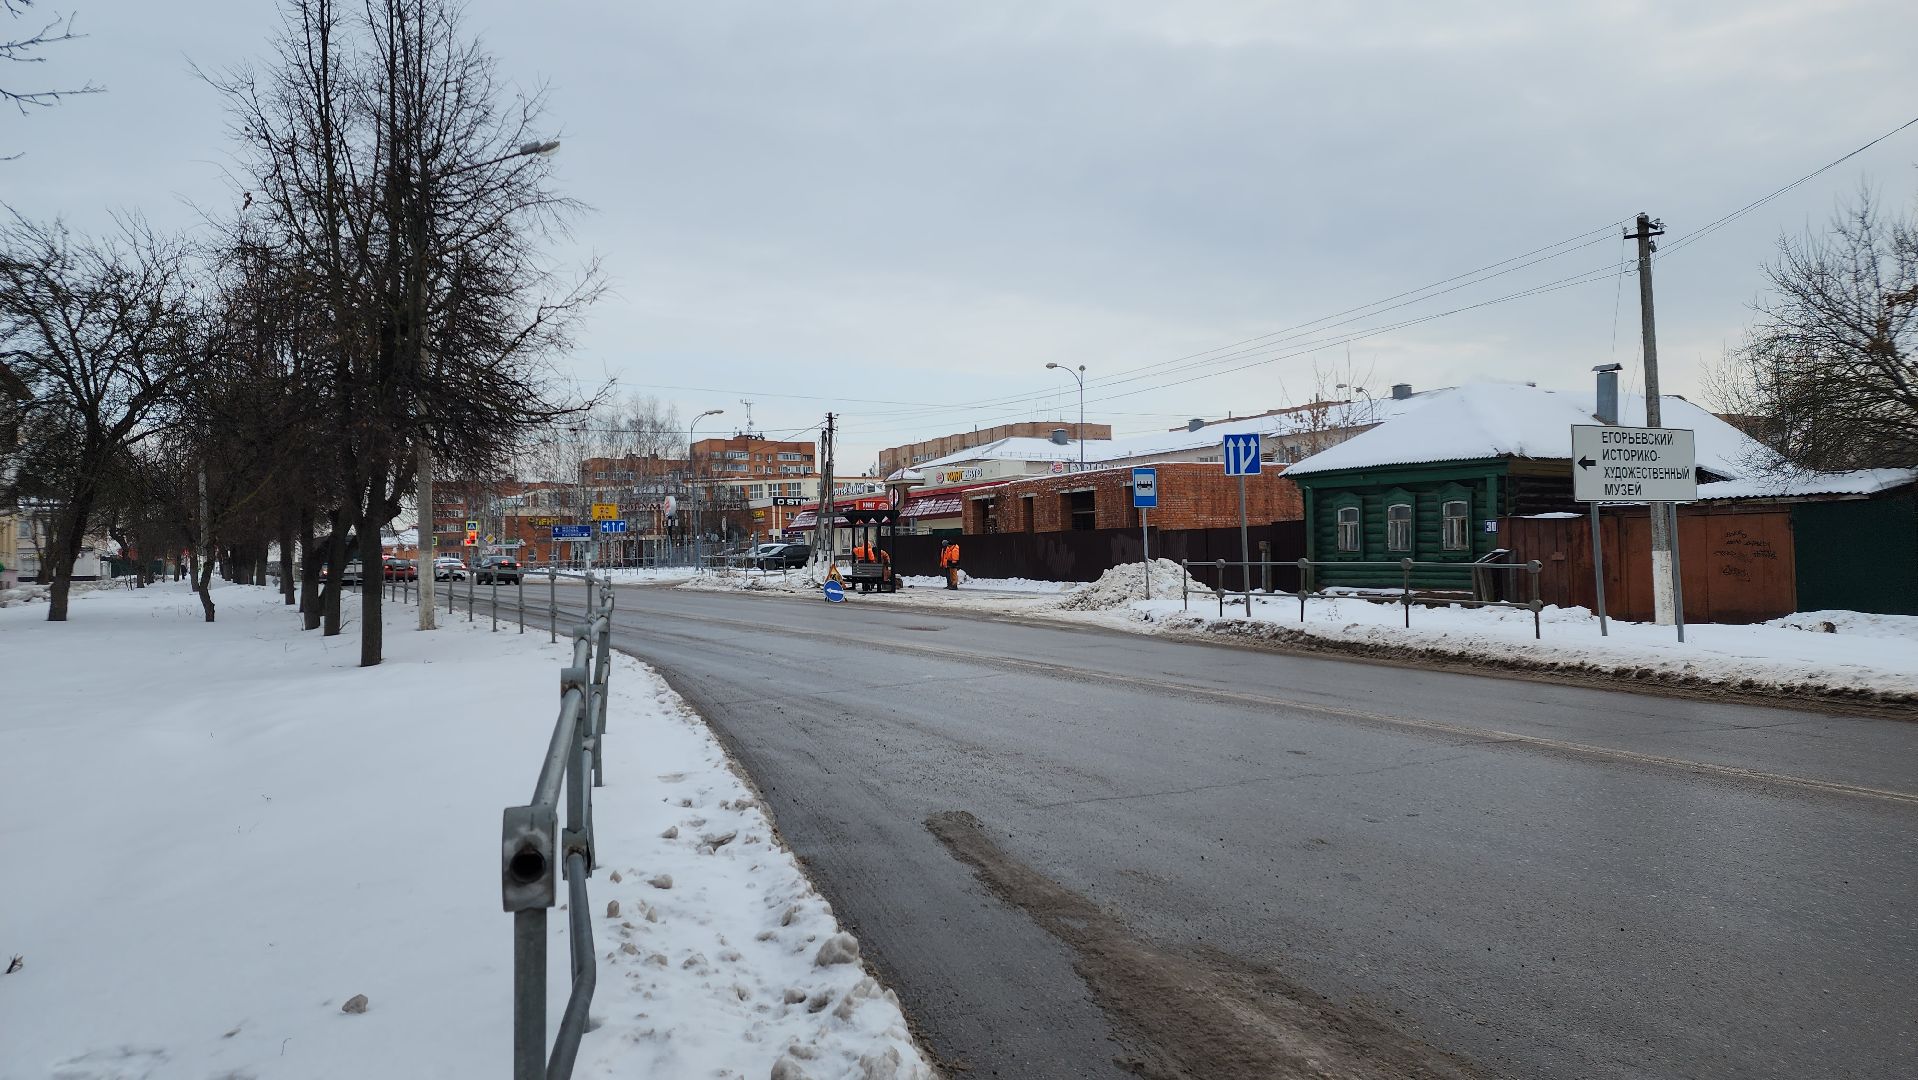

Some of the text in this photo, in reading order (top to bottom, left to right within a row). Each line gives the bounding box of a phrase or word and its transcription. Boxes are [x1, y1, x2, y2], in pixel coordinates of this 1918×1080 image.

[1601, 430, 1674, 446] ЕГОРЬЕВСКИЙ
[1602, 448, 1661, 462] ИСТОРИКО-
[1604, 465, 1690, 481] ХУДОЖЕСТВЕННЫЙ
[1604, 481, 1643, 496] МУЗЕЙ
[1486, 521, 1497, 532] 30
